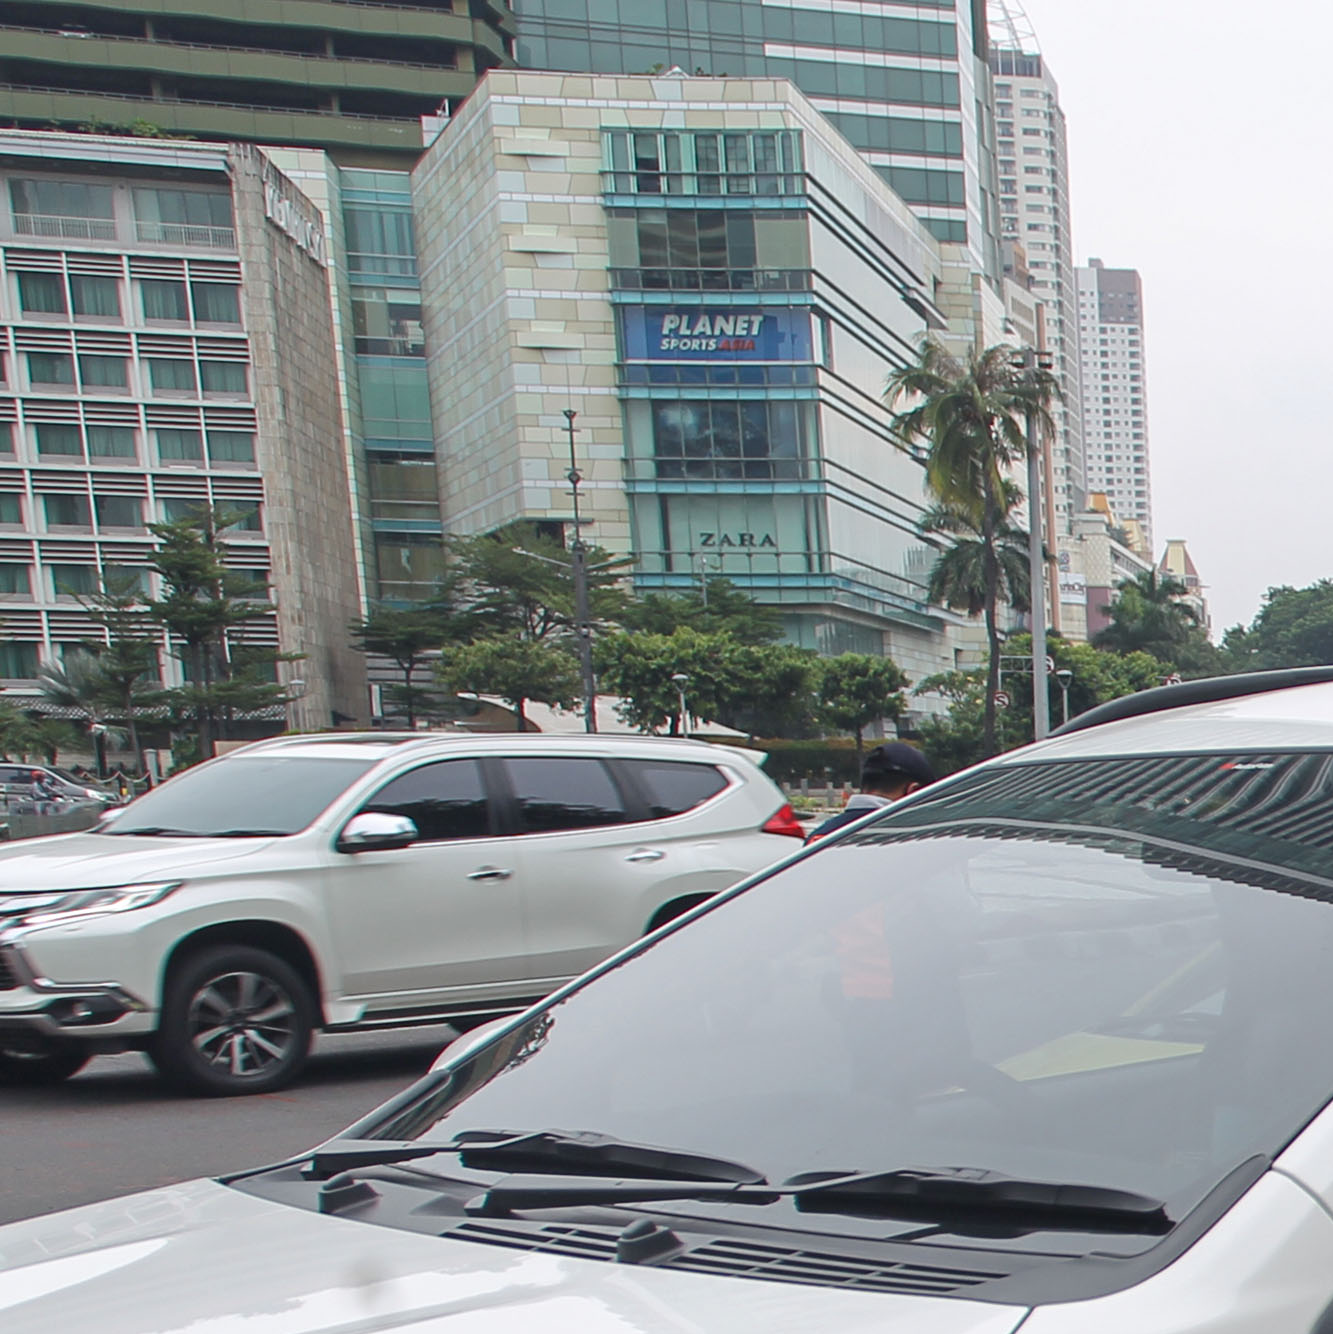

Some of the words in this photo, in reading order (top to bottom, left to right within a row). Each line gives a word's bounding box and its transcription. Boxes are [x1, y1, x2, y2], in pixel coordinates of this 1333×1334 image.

[662, 314, 763, 336] PLANET
[660, 338, 717, 351] SPORTS
[718, 339, 755, 350] ASIA
[700, 532, 777, 547] ZARA
